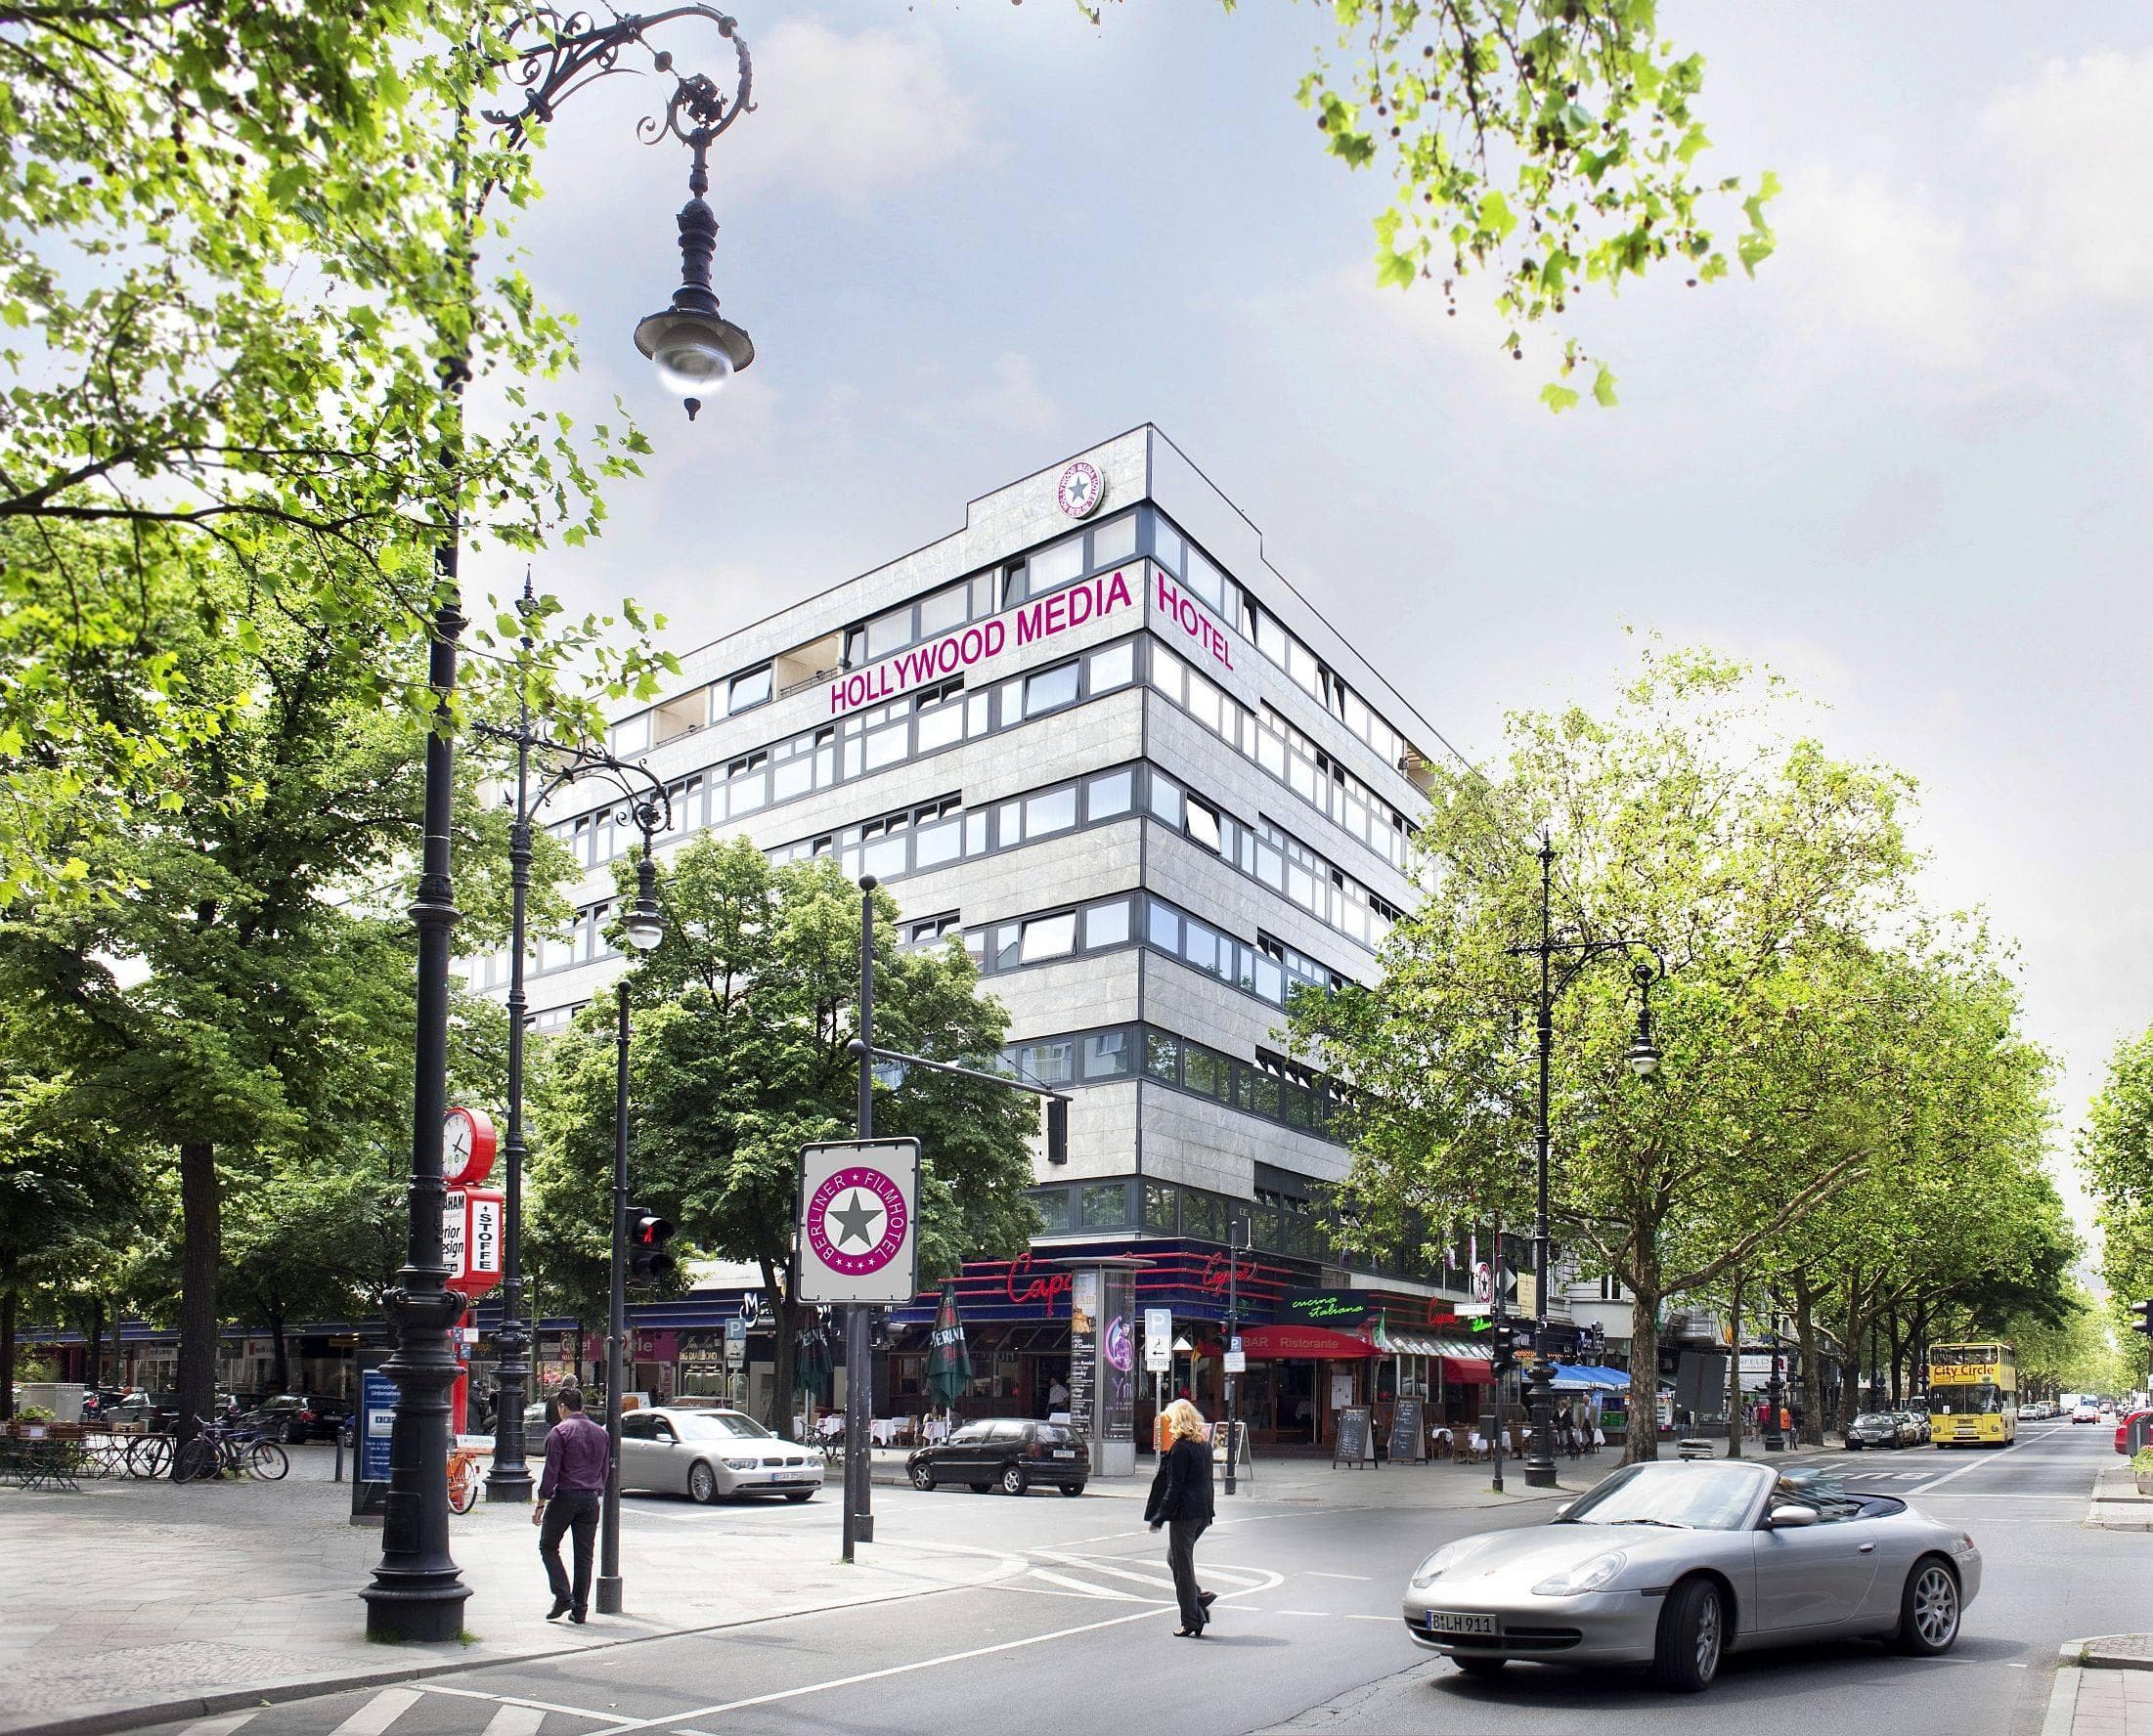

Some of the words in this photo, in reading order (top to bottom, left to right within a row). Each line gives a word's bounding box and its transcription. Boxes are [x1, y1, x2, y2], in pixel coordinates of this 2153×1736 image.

[831, 621, 1005, 715] HOLLYWOOD
[1017, 571, 1132, 647] MEDIA
[1159, 572, 1234, 672] HOTEL
[443, 1194, 464, 1211] AHAM
[810, 1175, 846, 1260] BERLINER
[864, 1172, 904, 1259] FILMHOTEL
[443, 1226, 461, 1238] rior
[442, 1239, 464, 1258] esign
[478, 1214, 493, 1270] STOFFE
[1292, 1296, 1339, 1309] cucina
[1307, 1304, 1364, 1319] italiana
[730, 1322, 741, 1333] P
[1151, 1313, 1165, 1333] P
[1243, 1337, 1269, 1348] BAR
[1280, 1337, 1339, 1349] Ristorante
[1935, 1366, 1957, 1376] City
[1961, 1365, 1995, 1375] Circle
[1466, 1617, 1492, 1633] 911
